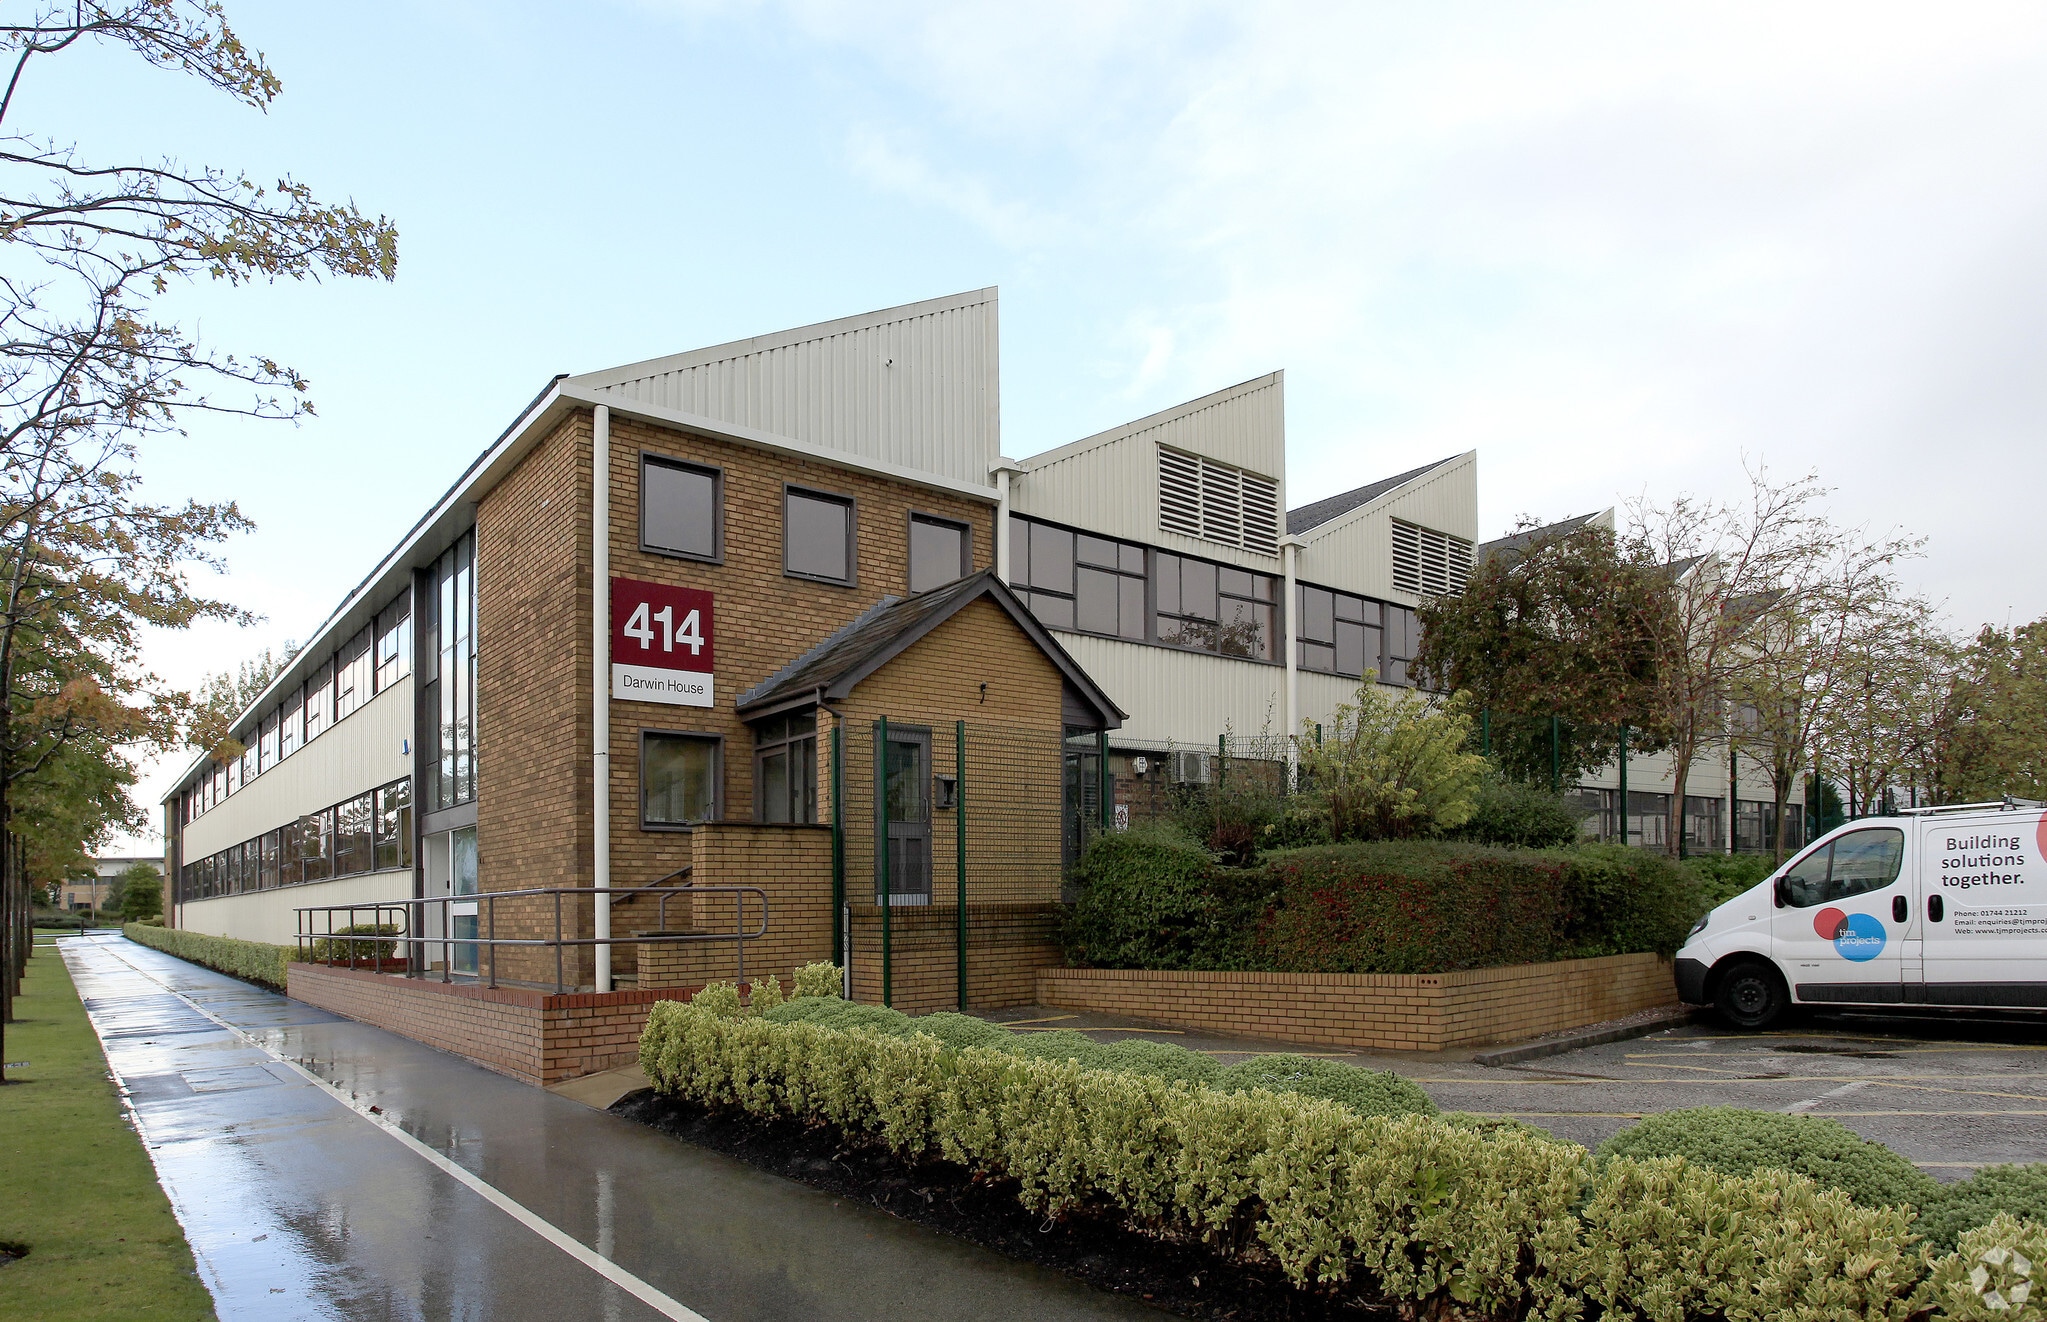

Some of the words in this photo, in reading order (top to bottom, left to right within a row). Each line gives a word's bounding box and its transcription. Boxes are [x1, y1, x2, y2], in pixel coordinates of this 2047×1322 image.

[624, 602, 704, 656] 414
[623, 675, 665, 690] Darwin
[667, 679, 704, 694] House
[1946, 835, 2020, 850] Building
[1941, 854, 2025, 868] solutions
[1941, 871, 2025, 889] together.
[1840, 936, 1880, 946] projects
